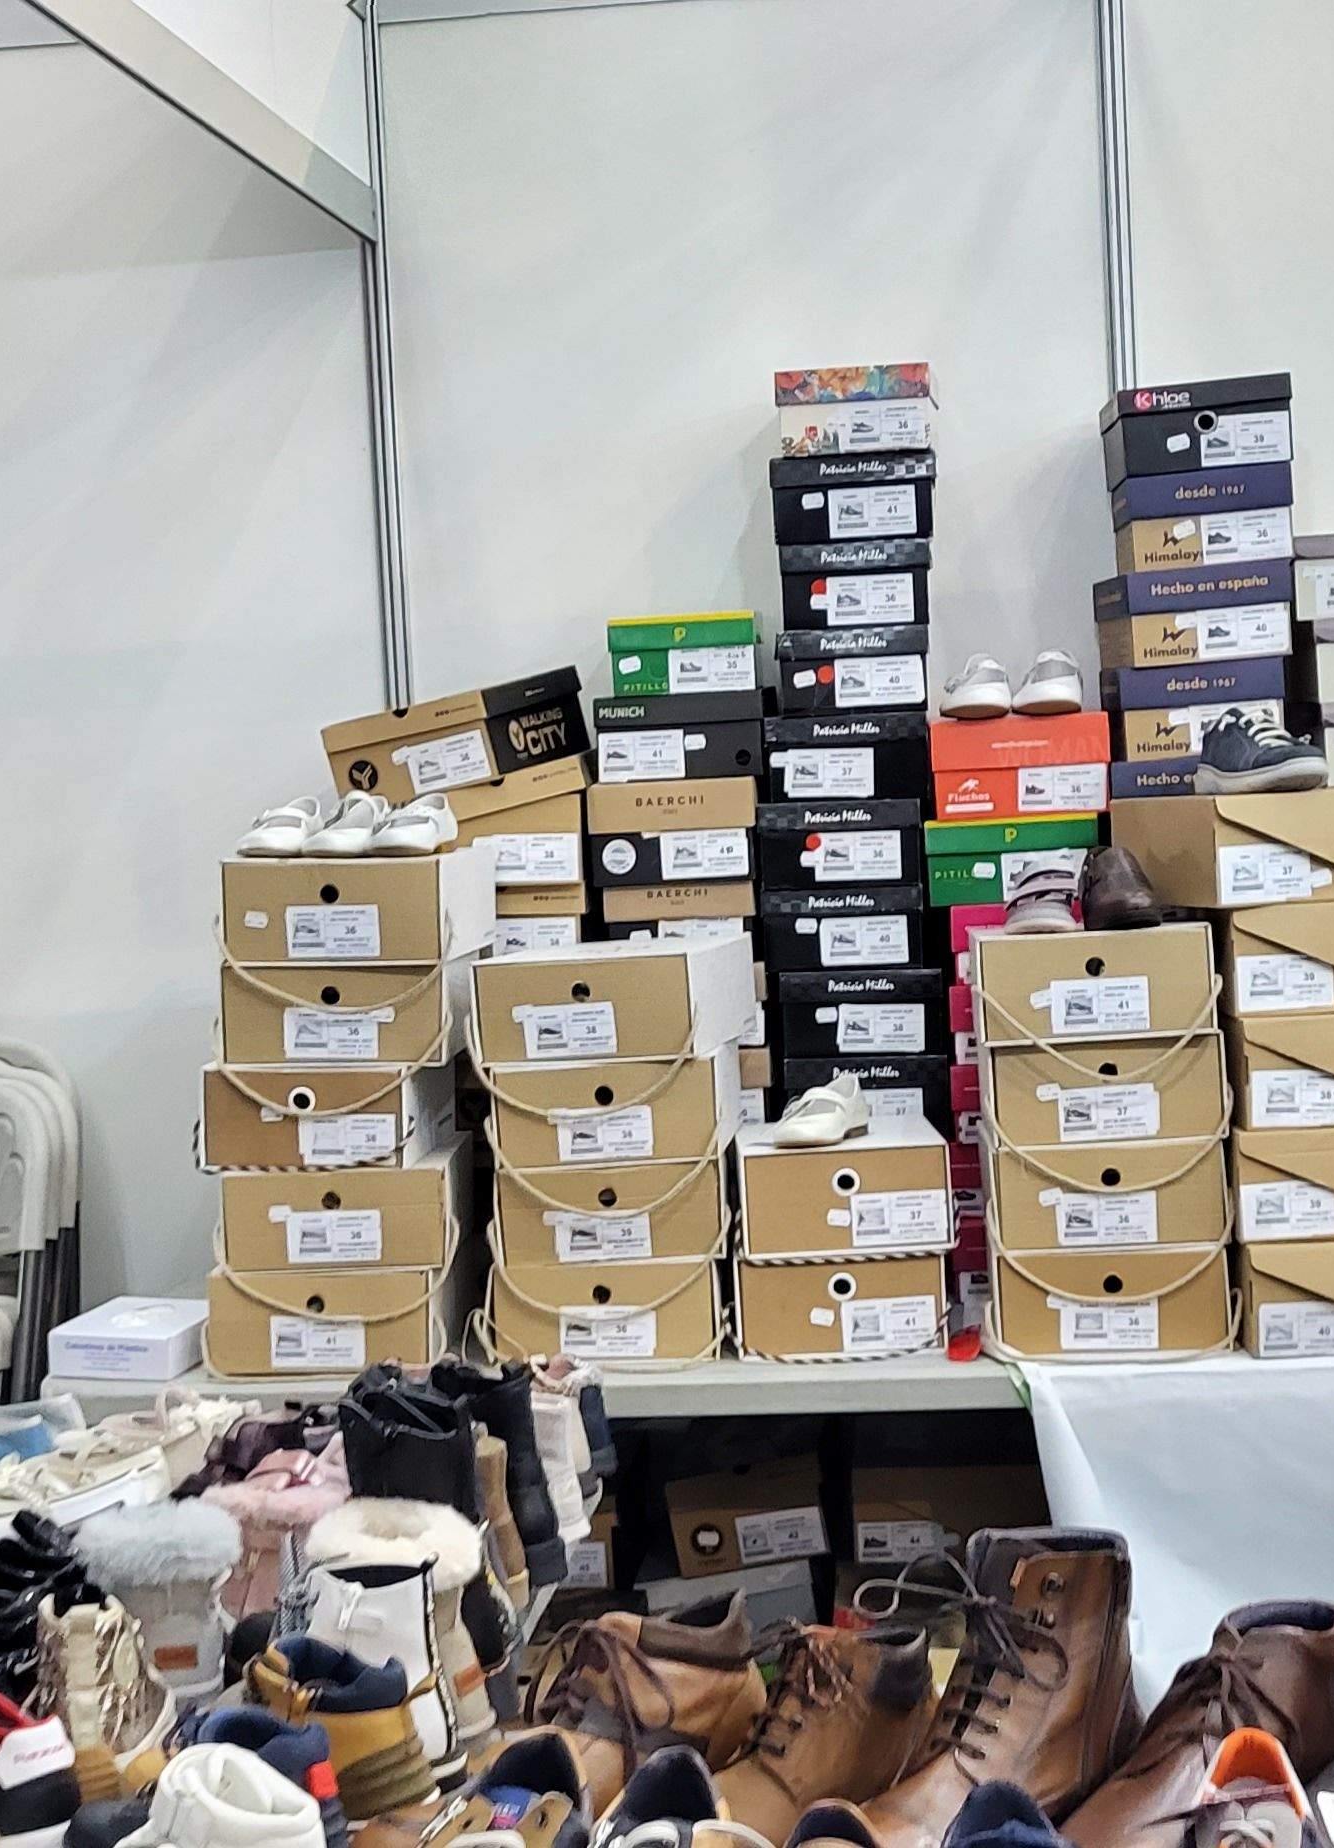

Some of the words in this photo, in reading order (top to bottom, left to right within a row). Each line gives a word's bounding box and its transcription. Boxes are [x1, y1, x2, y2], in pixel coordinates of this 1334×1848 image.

[1175, 484, 1216, 500] desde
[887, 505, 898, 514] 41
[1144, 549, 1200, 564] Himalay
[1151, 580, 1194, 596] Hecho
[1197, 580, 1215, 592] en
[1255, 624, 1267, 632] 40
[1143, 645, 1199, 659] Himalay
[889, 675, 900, 684] 40
[1167, 676, 1207, 692] desde
[623, 681, 668, 692] PITILLO
[598, 706, 644, 719] MUNICH
[519, 707, 563, 729] WALKING
[526, 722, 566, 755] CITY
[1136, 738, 1191, 753] Himalay
[842, 767, 852, 776] 37
[1137, 772, 1180, 786] Hecho
[635, 794, 704, 808] BAERCHI
[1282, 866, 1293, 875] 37
[646, 888, 708, 899] BAERCHI
[345, 925, 357, 935] 36
[879, 934, 891, 943] 40
[1118, 1001, 1130, 1009] 41
[348, 1027, 359, 1036] 36
[1117, 1107, 1128, 1116] 37
[910, 1211, 921, 1219] 37
[621, 1228, 632, 1237] 39
[905, 1317, 916, 1326] 41
